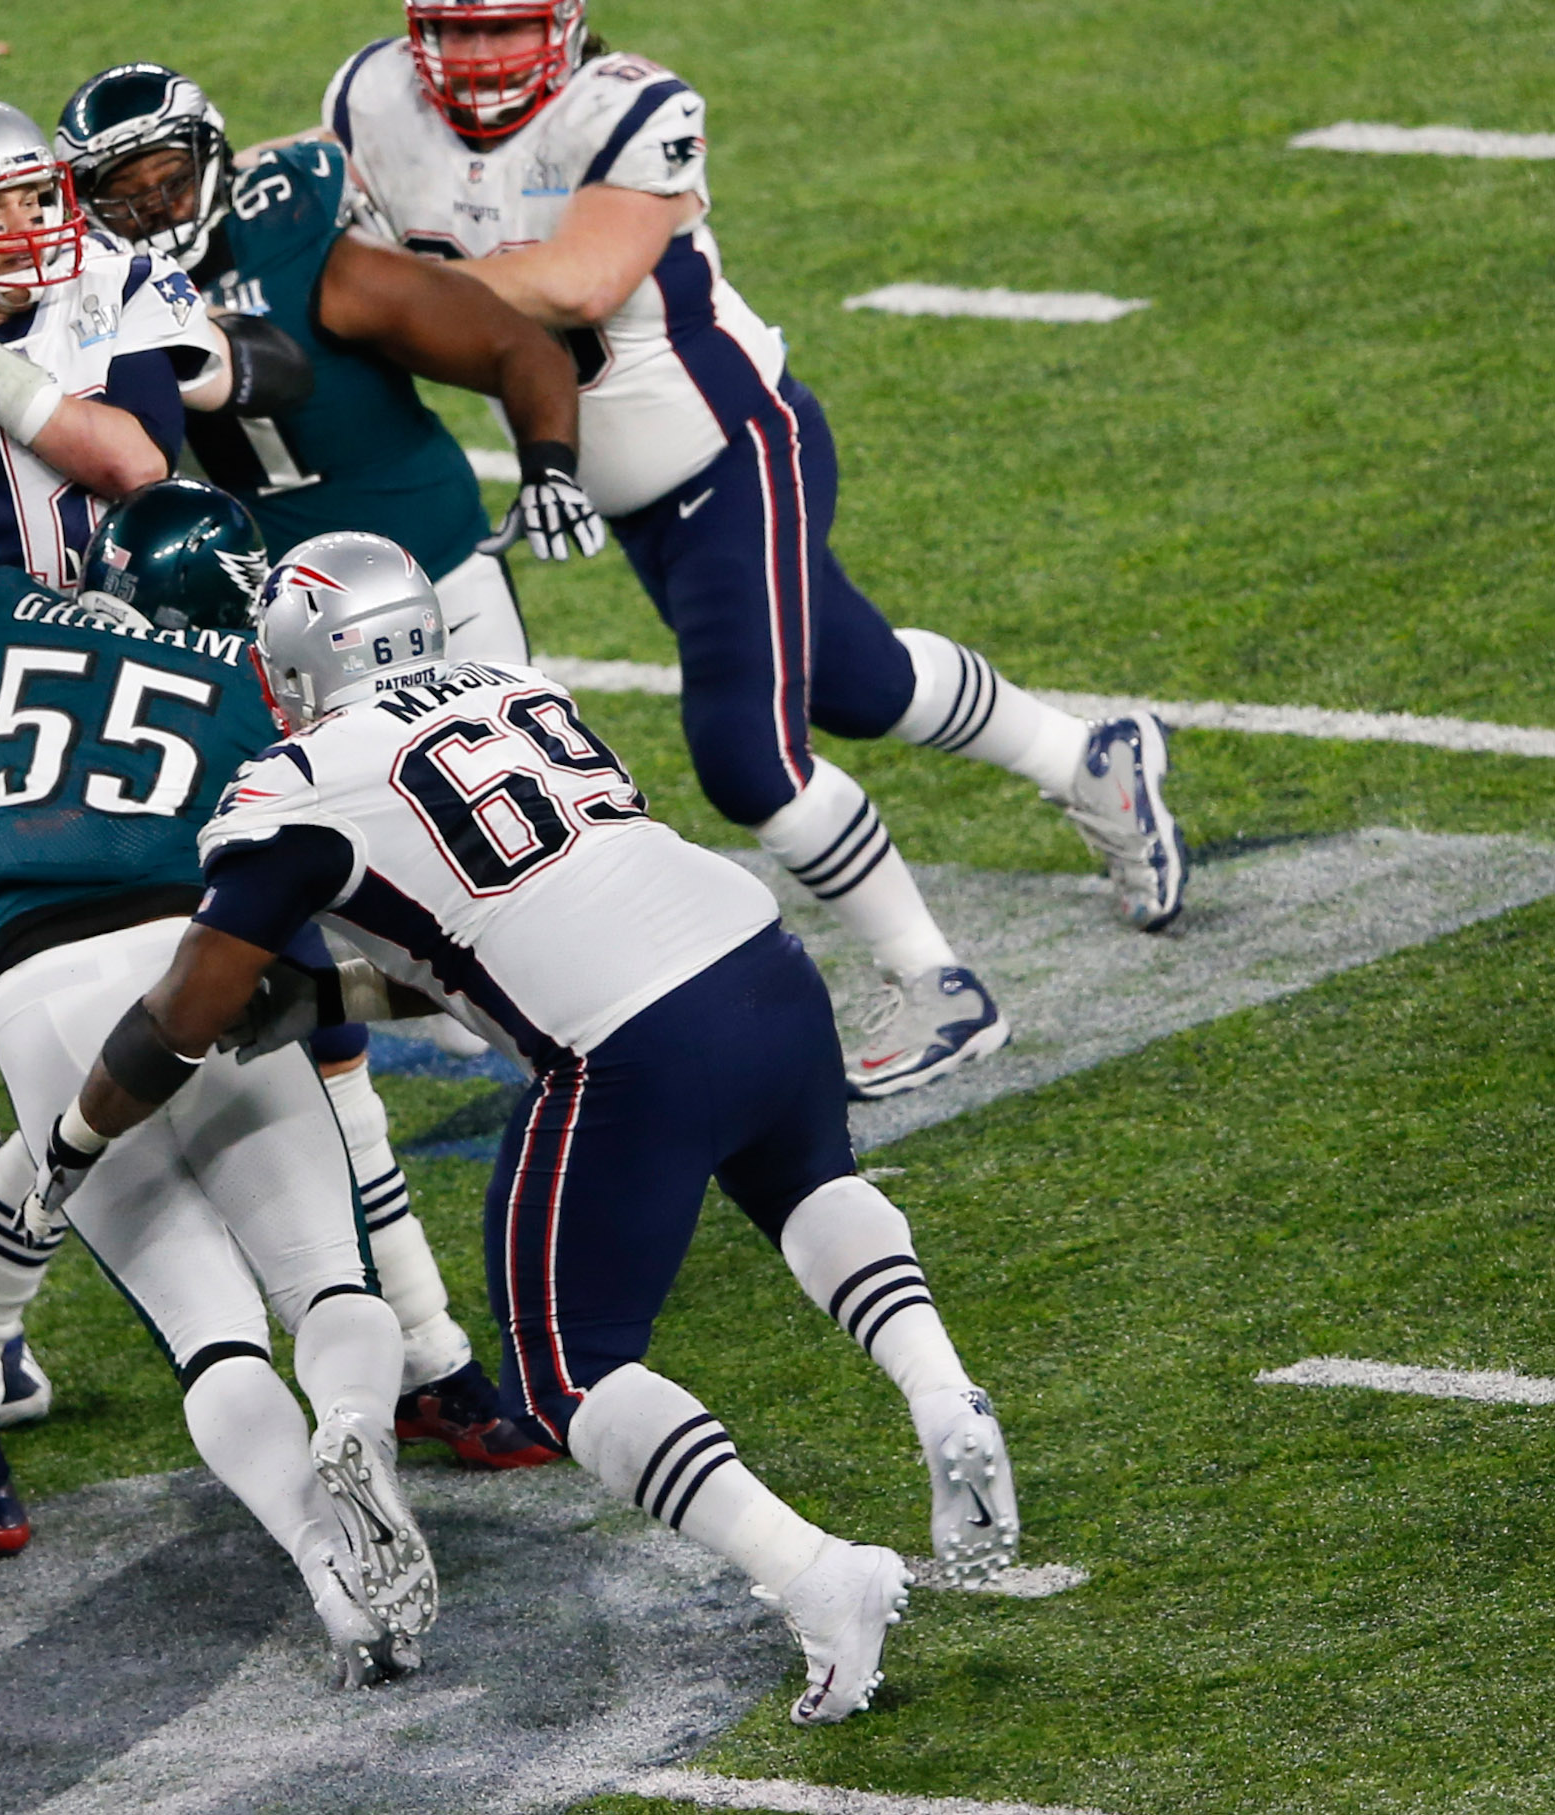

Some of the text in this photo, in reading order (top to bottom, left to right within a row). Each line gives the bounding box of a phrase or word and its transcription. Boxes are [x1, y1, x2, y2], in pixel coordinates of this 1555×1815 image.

[101, 567, 139, 602] 55
[373, 628, 425, 665] 69
[375, 667, 436, 693] PATRIOTS
[390, 688, 649, 898] 69
